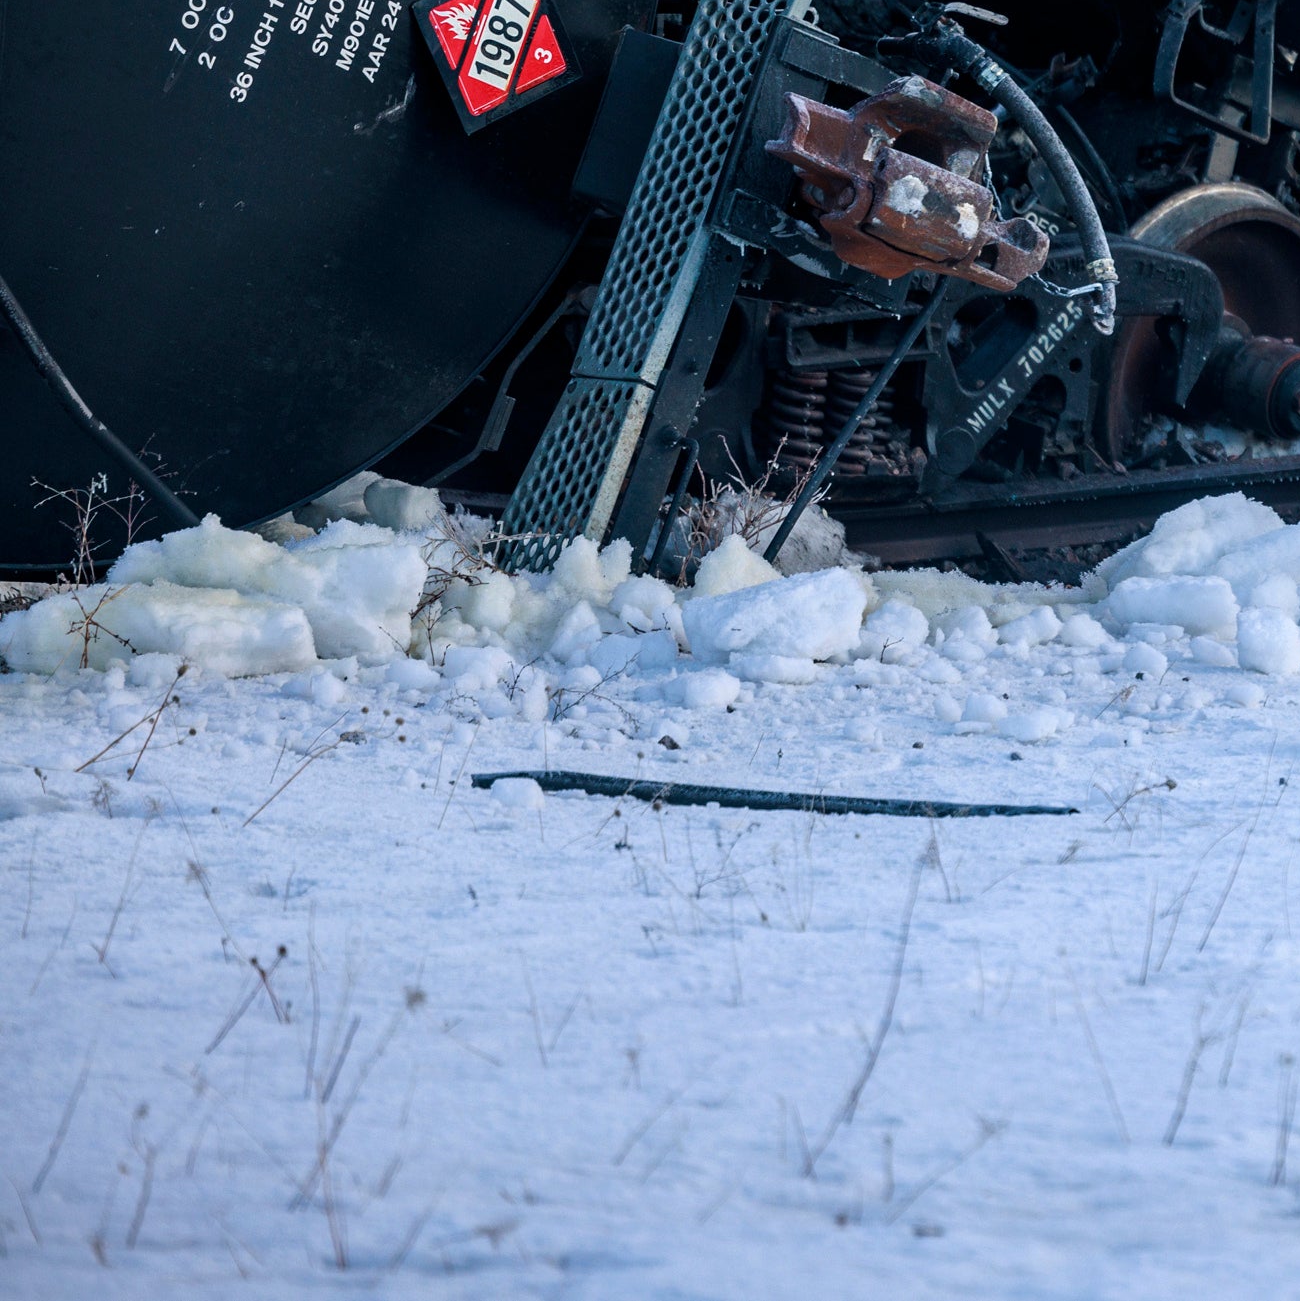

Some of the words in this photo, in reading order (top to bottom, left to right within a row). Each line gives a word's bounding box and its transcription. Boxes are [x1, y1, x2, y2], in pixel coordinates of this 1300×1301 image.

[169, 37, 187, 55] 7
[198, 52, 217, 70] 2
[208, 6, 235, 42] OC
[229, 71, 254, 104] 36
[243, 12, 279, 69] INCH
[361, 32, 391, 84] AAR
[380, 0, 403, 31] 24
[534, 47, 553, 64] 3
[966, 377, 1015, 434] MULX
[1017, 300, 1084, 378] 702625
